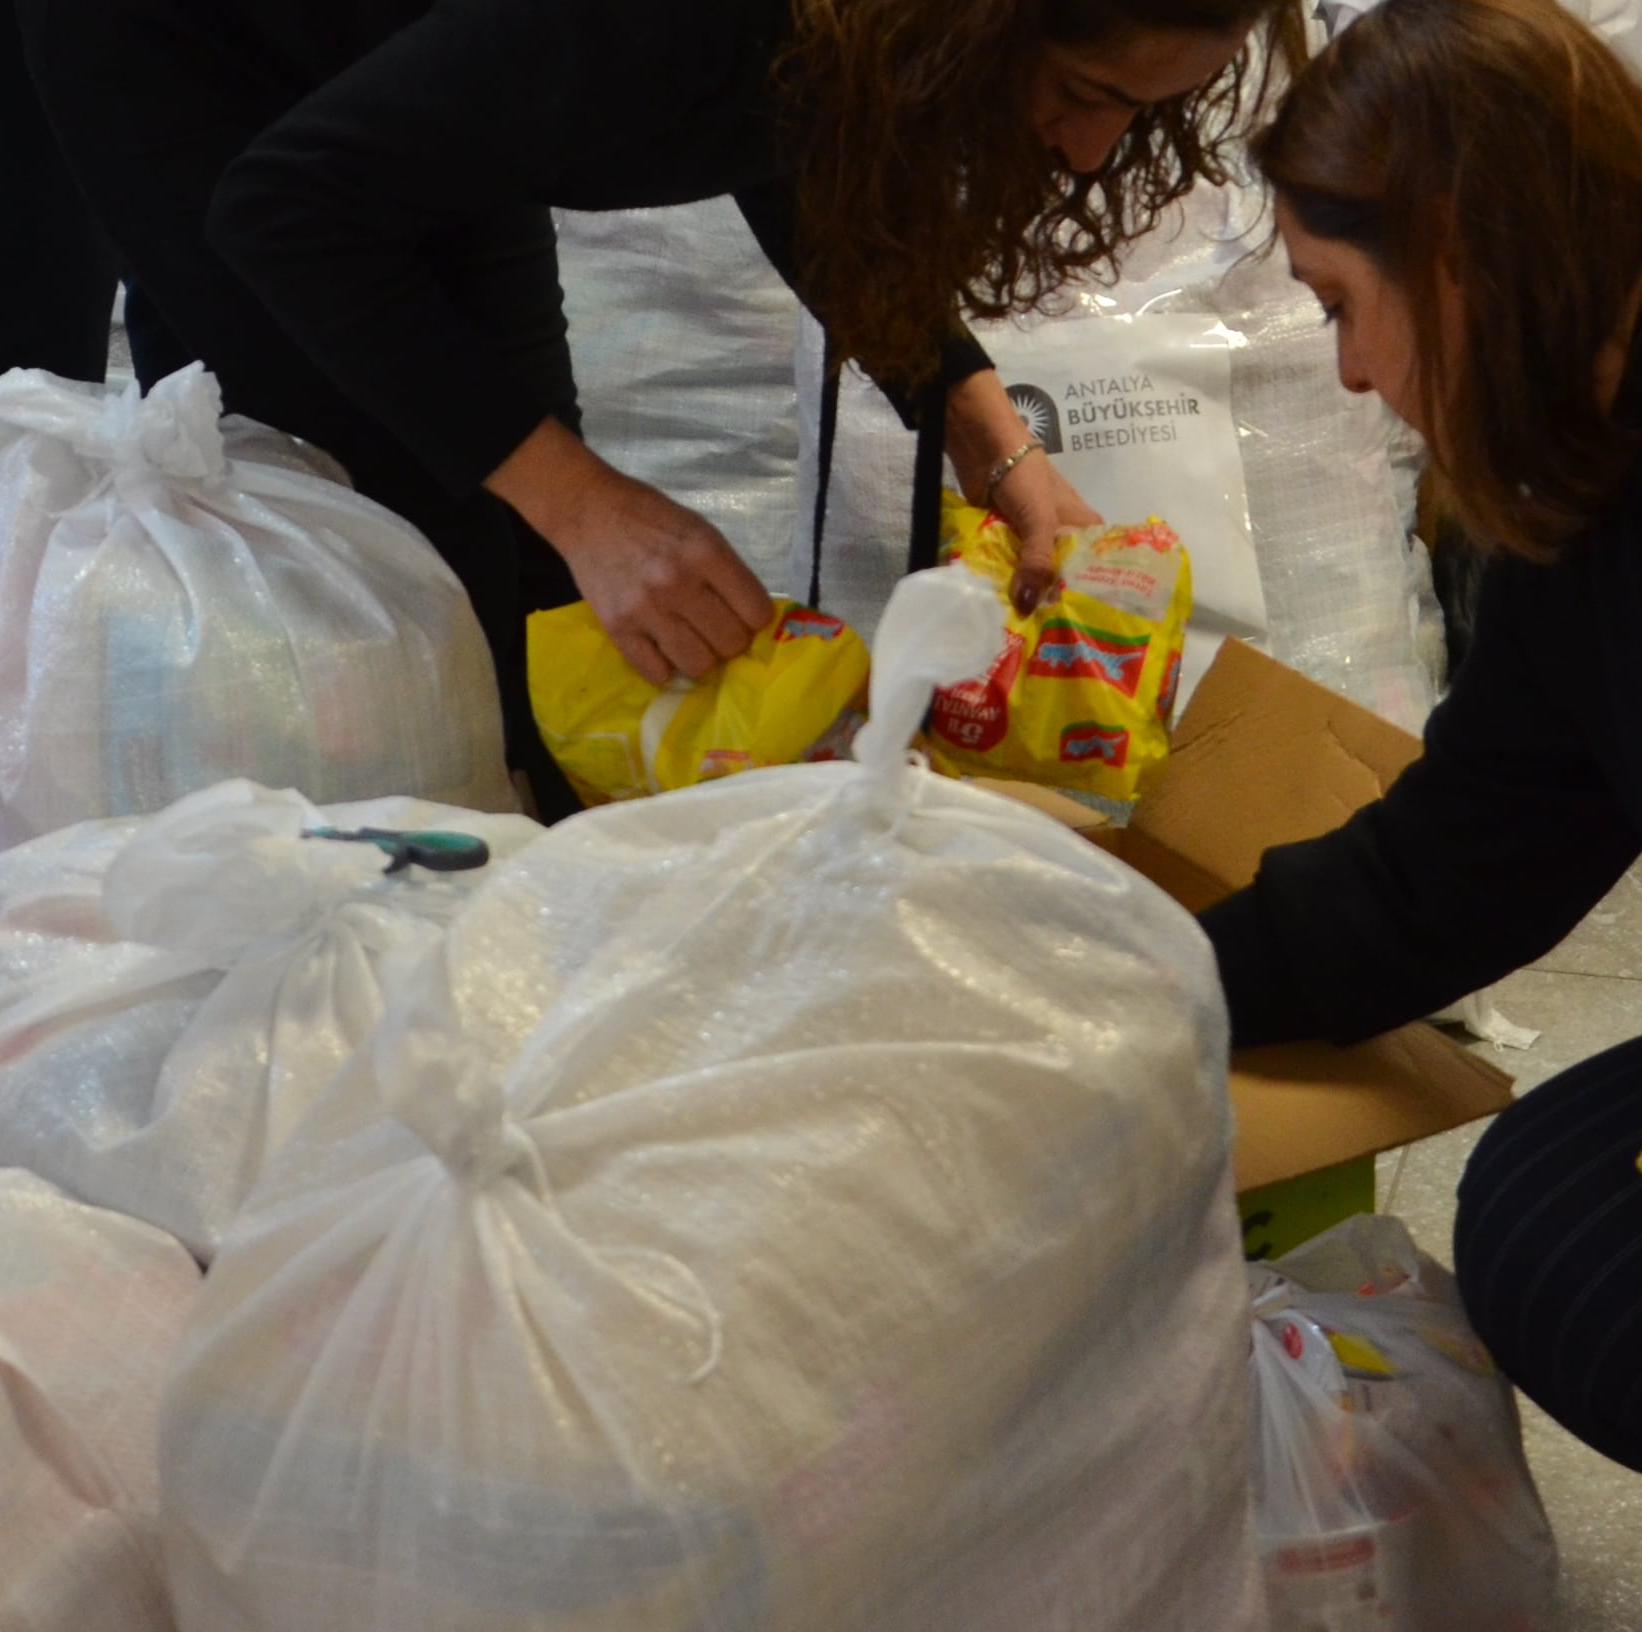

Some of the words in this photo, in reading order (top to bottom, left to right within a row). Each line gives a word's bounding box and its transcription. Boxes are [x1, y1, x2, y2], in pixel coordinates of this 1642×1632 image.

[1063, 374, 1155, 401] ANTALYA
[1067, 392, 1201, 426] BÜYÜKŞEHİR
[1070, 419, 1178, 453] BELEDİYESİ
